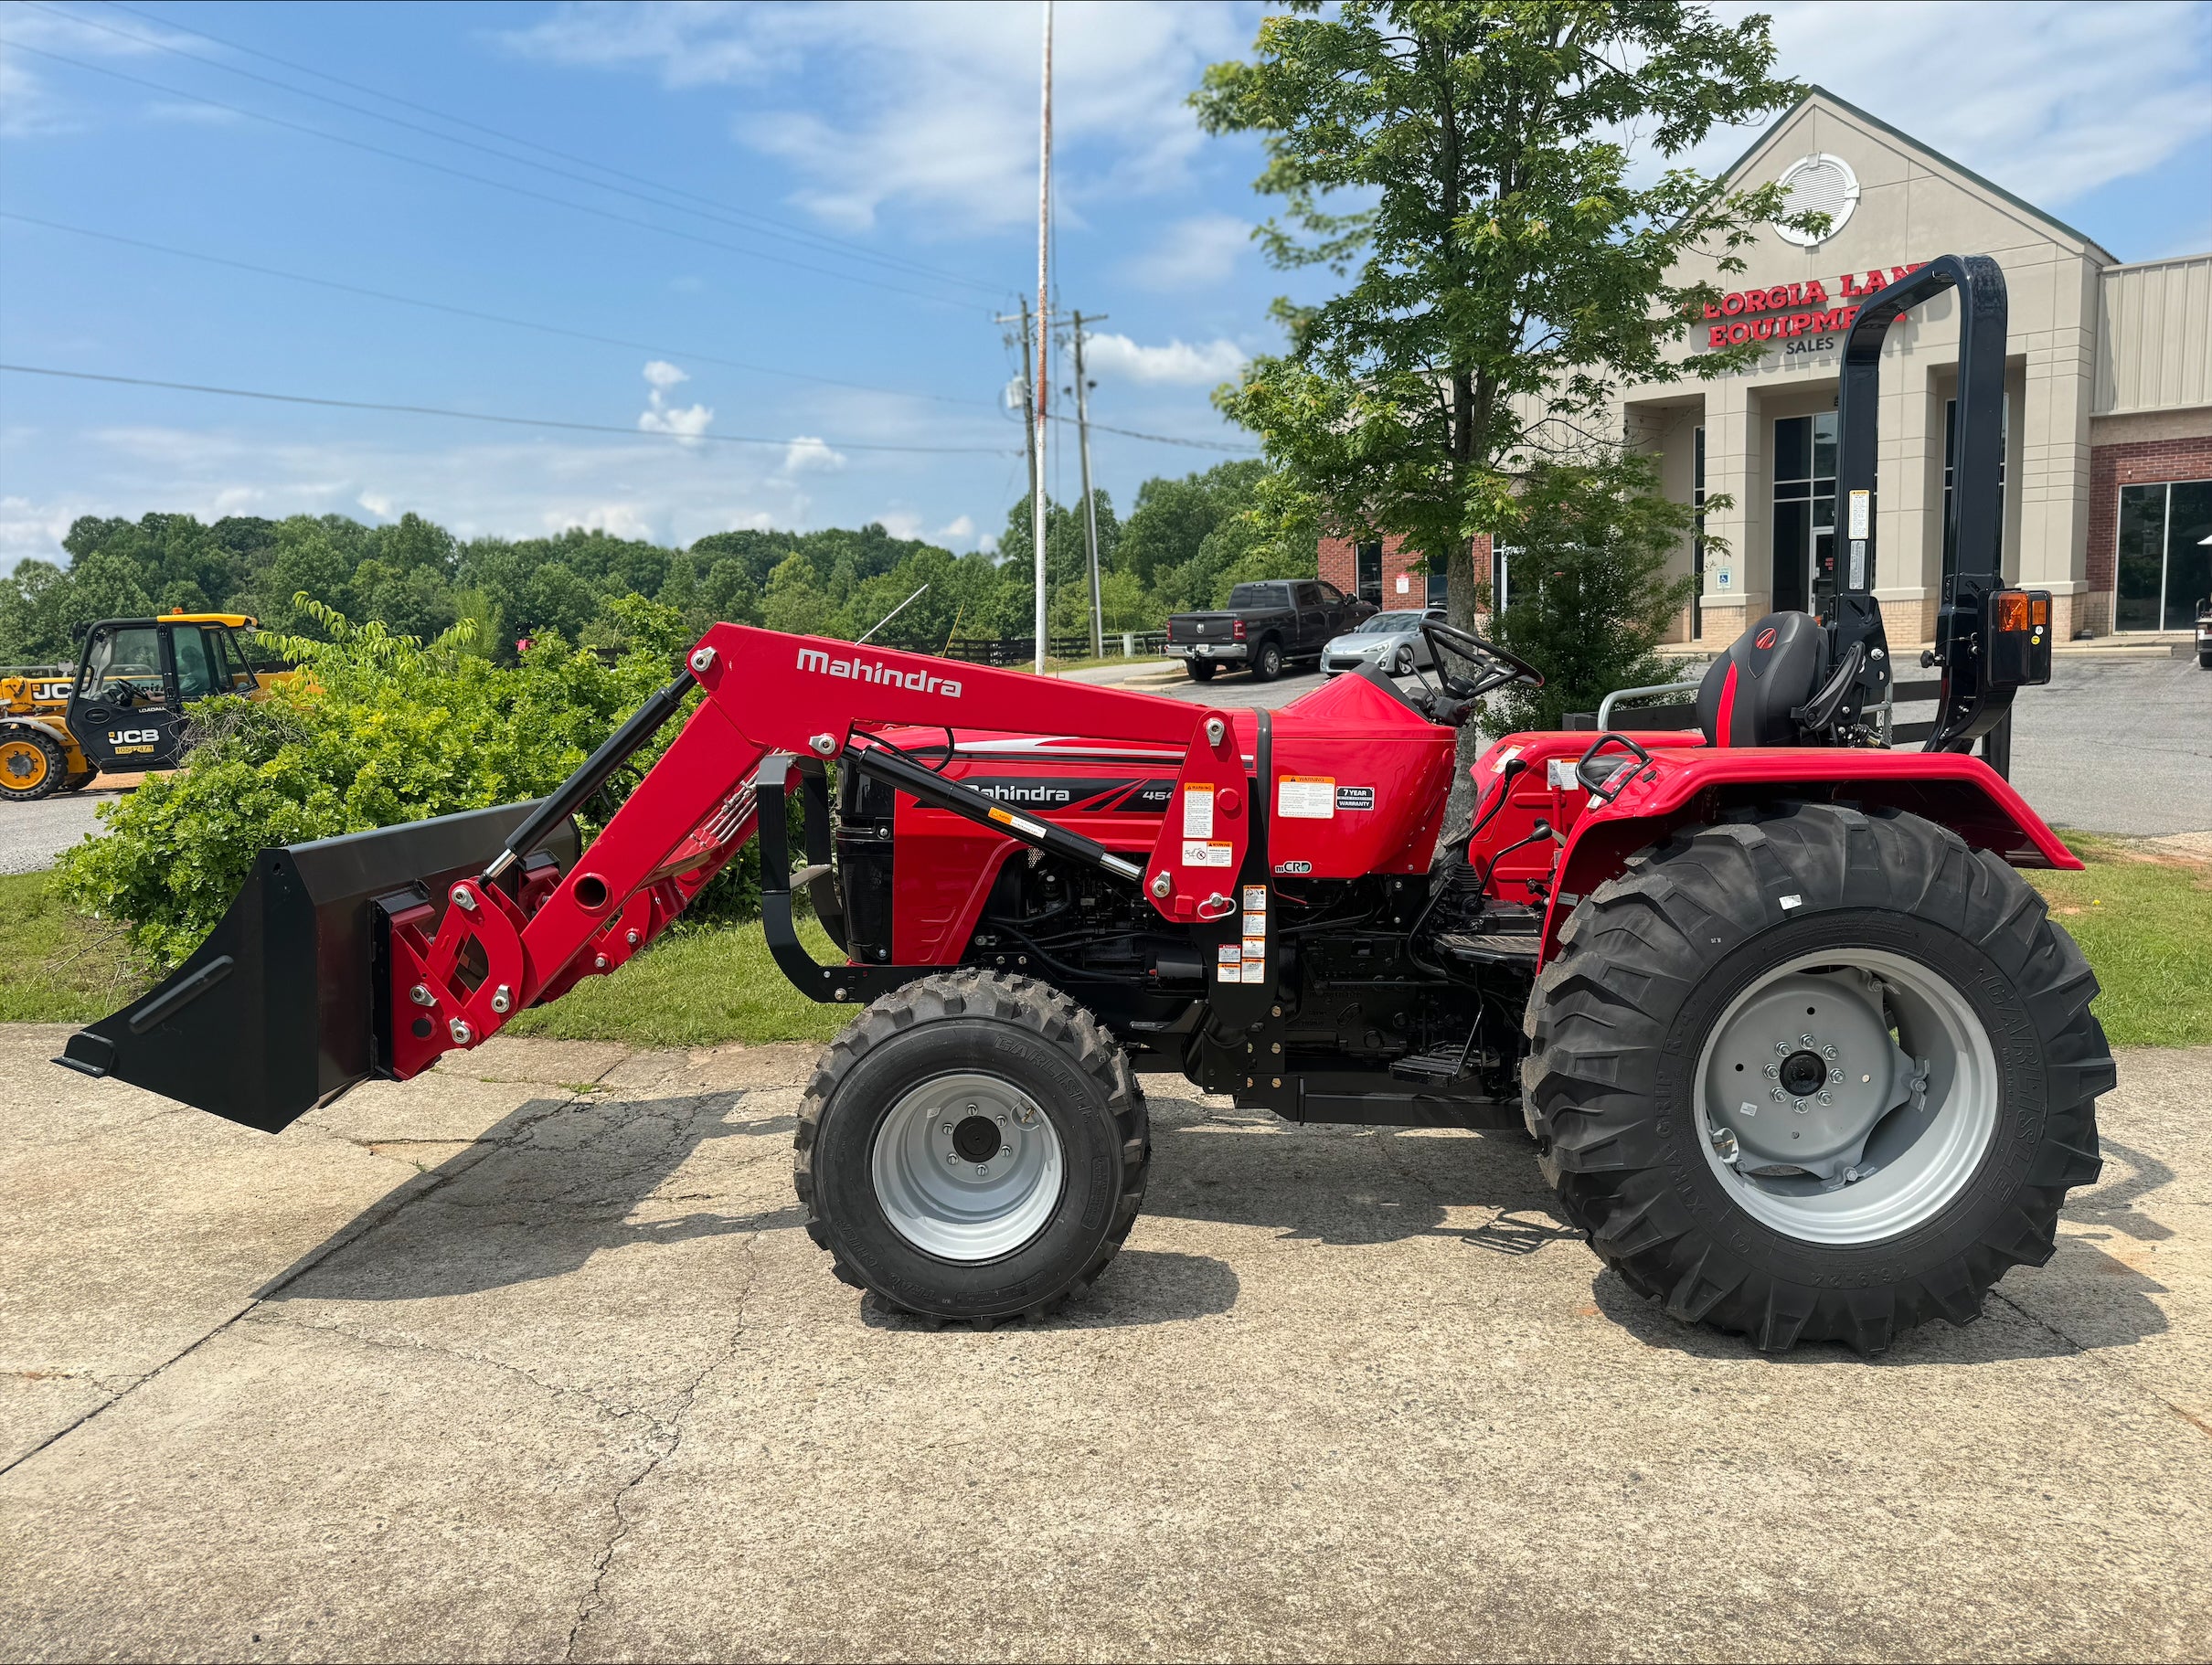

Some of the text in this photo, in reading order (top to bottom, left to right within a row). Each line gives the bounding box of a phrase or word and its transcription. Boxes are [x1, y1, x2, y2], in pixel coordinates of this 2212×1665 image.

[1683, 261, 1930, 319] EORGIA LAN
[1708, 304, 1907, 348] EQUIPME
[1786, 336, 1834, 355] SALES
[796, 648, 962, 698] Mahindra
[32, 683, 75, 700] JC
[108, 728, 160, 745] JCB
[1344, 789, 1349, 797] 7
